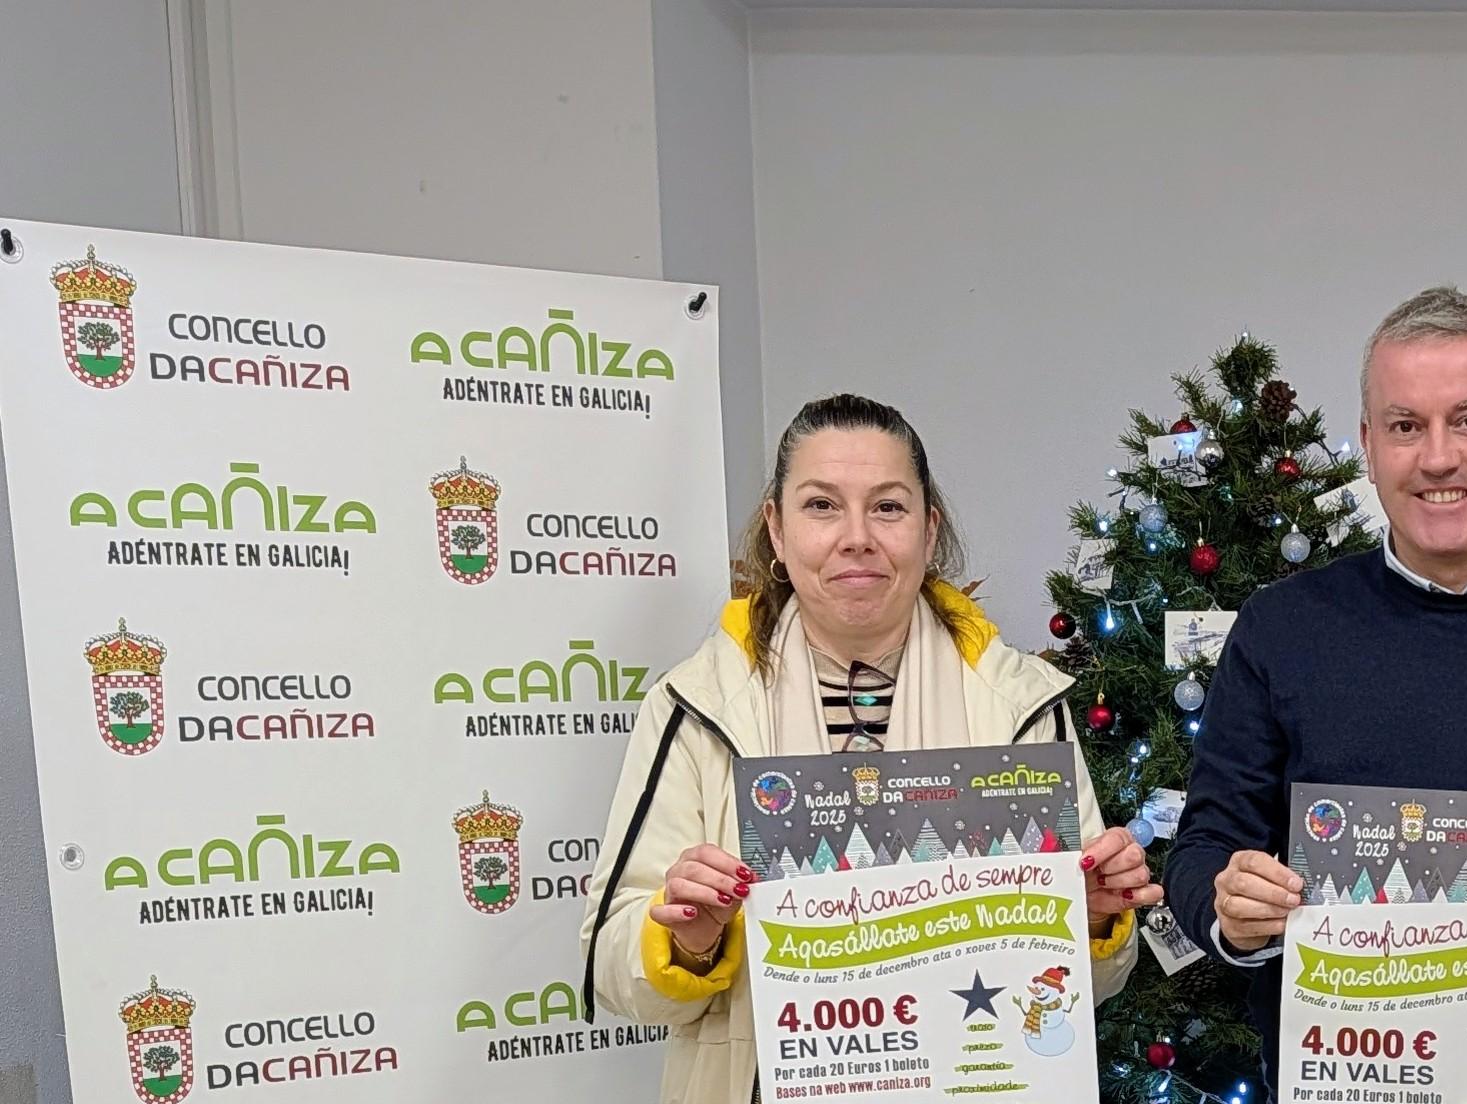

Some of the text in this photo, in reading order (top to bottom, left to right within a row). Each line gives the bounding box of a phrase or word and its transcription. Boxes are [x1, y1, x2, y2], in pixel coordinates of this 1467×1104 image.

[169, 314, 326, 350] CONCELLO
[444, 376, 651, 418] ADÉNTRATE EN GALICIA!
[527, 514, 659, 540] CONCELLO
[108, 538, 349, 576] ADÉNTRATE EN GALICIA!
[198, 675, 352, 702] CONCELLO
[466, 712, 595, 737] ADÉNTRATE EN
[140, 888, 373, 925] ADÉNTRATE EN GALICIA!
[776, 864, 1053, 925] A confianza de sempre
[925, 911, 972, 940] este
[977, 900, 1058, 929] Nadal
[1313, 915, 1333, 945] A
[763, 967, 800, 983] Dende
[814, 972, 838, 984] luns
[842, 970, 854, 982] 15
[858, 968, 872, 980] de
[875, 954, 929, 978] decembro
[933, 949, 951, 962] ata
[1011, 936, 1026, 949] de
[1028, 938, 1076, 956] febreiro
[225, 1012, 375, 1049] CONCELLO
[777, 994, 918, 1033] 4.000 €
[780, 1030, 919, 1060] EN VALES
[1301, 1025, 1437, 1060] 4.000 €
[775, 1067, 796, 1081] Por
[799, 1064, 827, 1079] cada
[830, 1062, 844, 1076] 20
[848, 1061, 882, 1075] Euros
[893, 1057, 930, 1072] boleto
[1301, 1060, 1434, 1085] EN VALES
[776, 1076, 931, 1100] Bases na web www.caniza.org
[1293, 1088, 1314, 1101] Por
[1317, 1088, 1343, 1102] cada
[1346, 1089, 1360, 1102] 20
[1363, 1090, 1396, 1103] Euros
[1406, 1091, 1442, 1104] boleto
